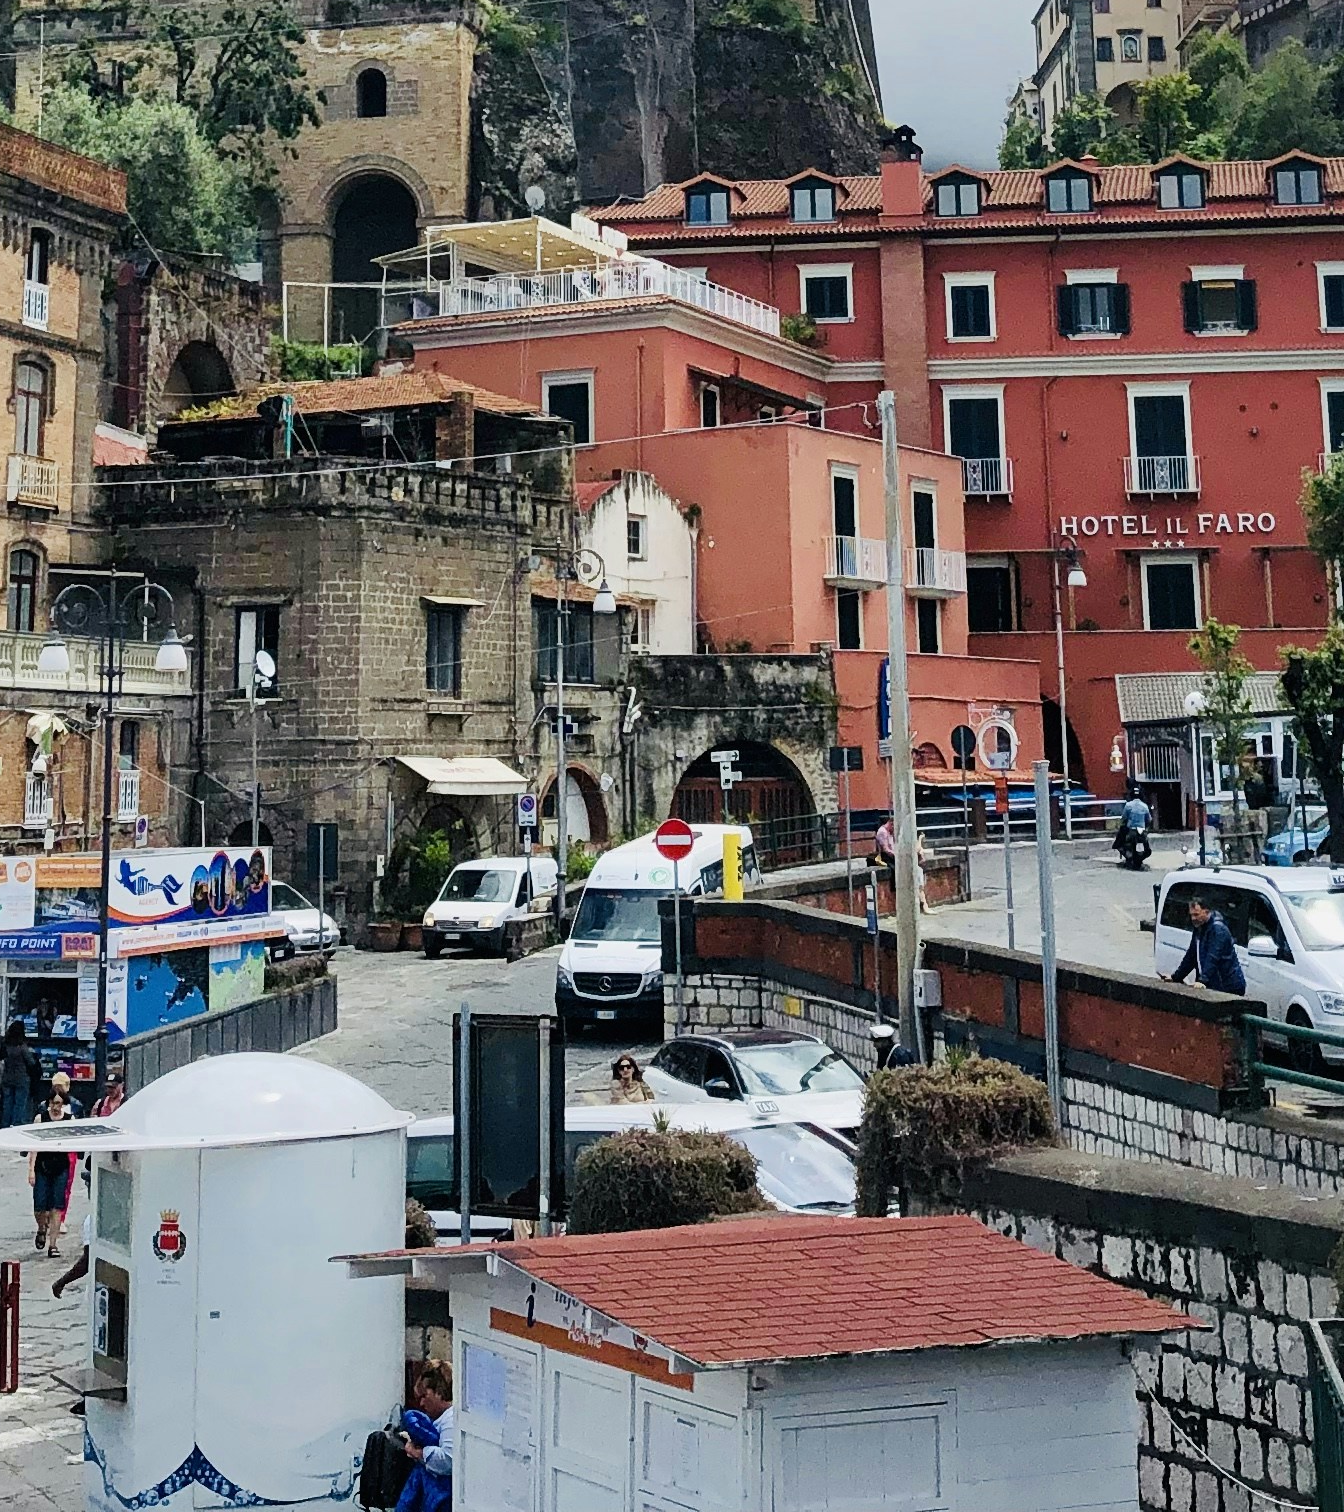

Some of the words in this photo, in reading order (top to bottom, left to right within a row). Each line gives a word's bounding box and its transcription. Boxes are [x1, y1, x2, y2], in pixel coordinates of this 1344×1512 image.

[1059, 515, 1157, 536] HOTEL
[1166, 517, 1189, 535] IL
[1197, 512, 1276, 534] FARO
[20, 938, 58, 949] POINT
